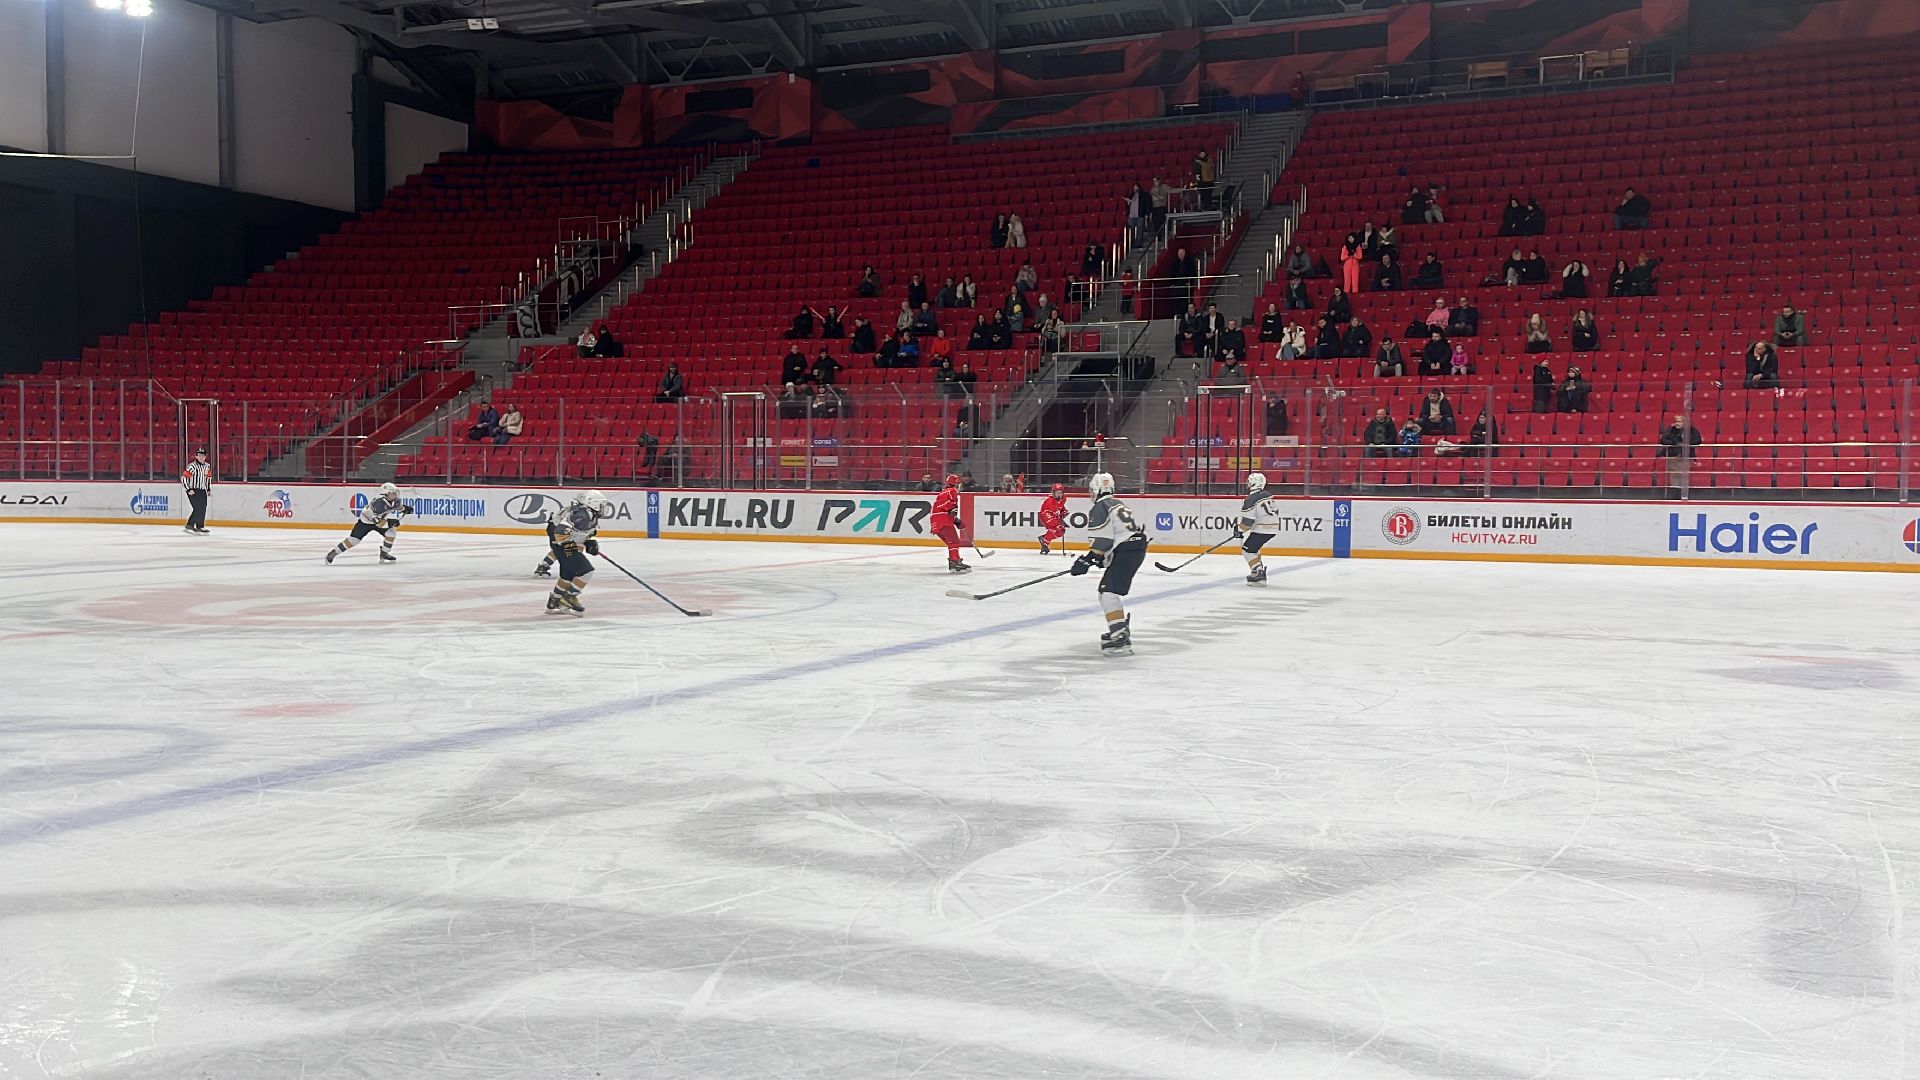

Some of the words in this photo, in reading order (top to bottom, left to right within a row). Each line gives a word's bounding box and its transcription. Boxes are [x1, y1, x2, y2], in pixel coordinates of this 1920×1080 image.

[263, 500, 283, 510] АВТО
[268, 509, 293, 518] РАДИО
[667, 497, 795, 529] KHL.RU
[817, 499, 931, 534] PAR
[1427, 515, 1496, 528] БИЛЕТЫ
[1501, 512, 1573, 530] ОНЛАЙН
[1451, 532, 1538, 545] HCVITYAZ.RU
[1668, 511, 1819, 554] Haier
